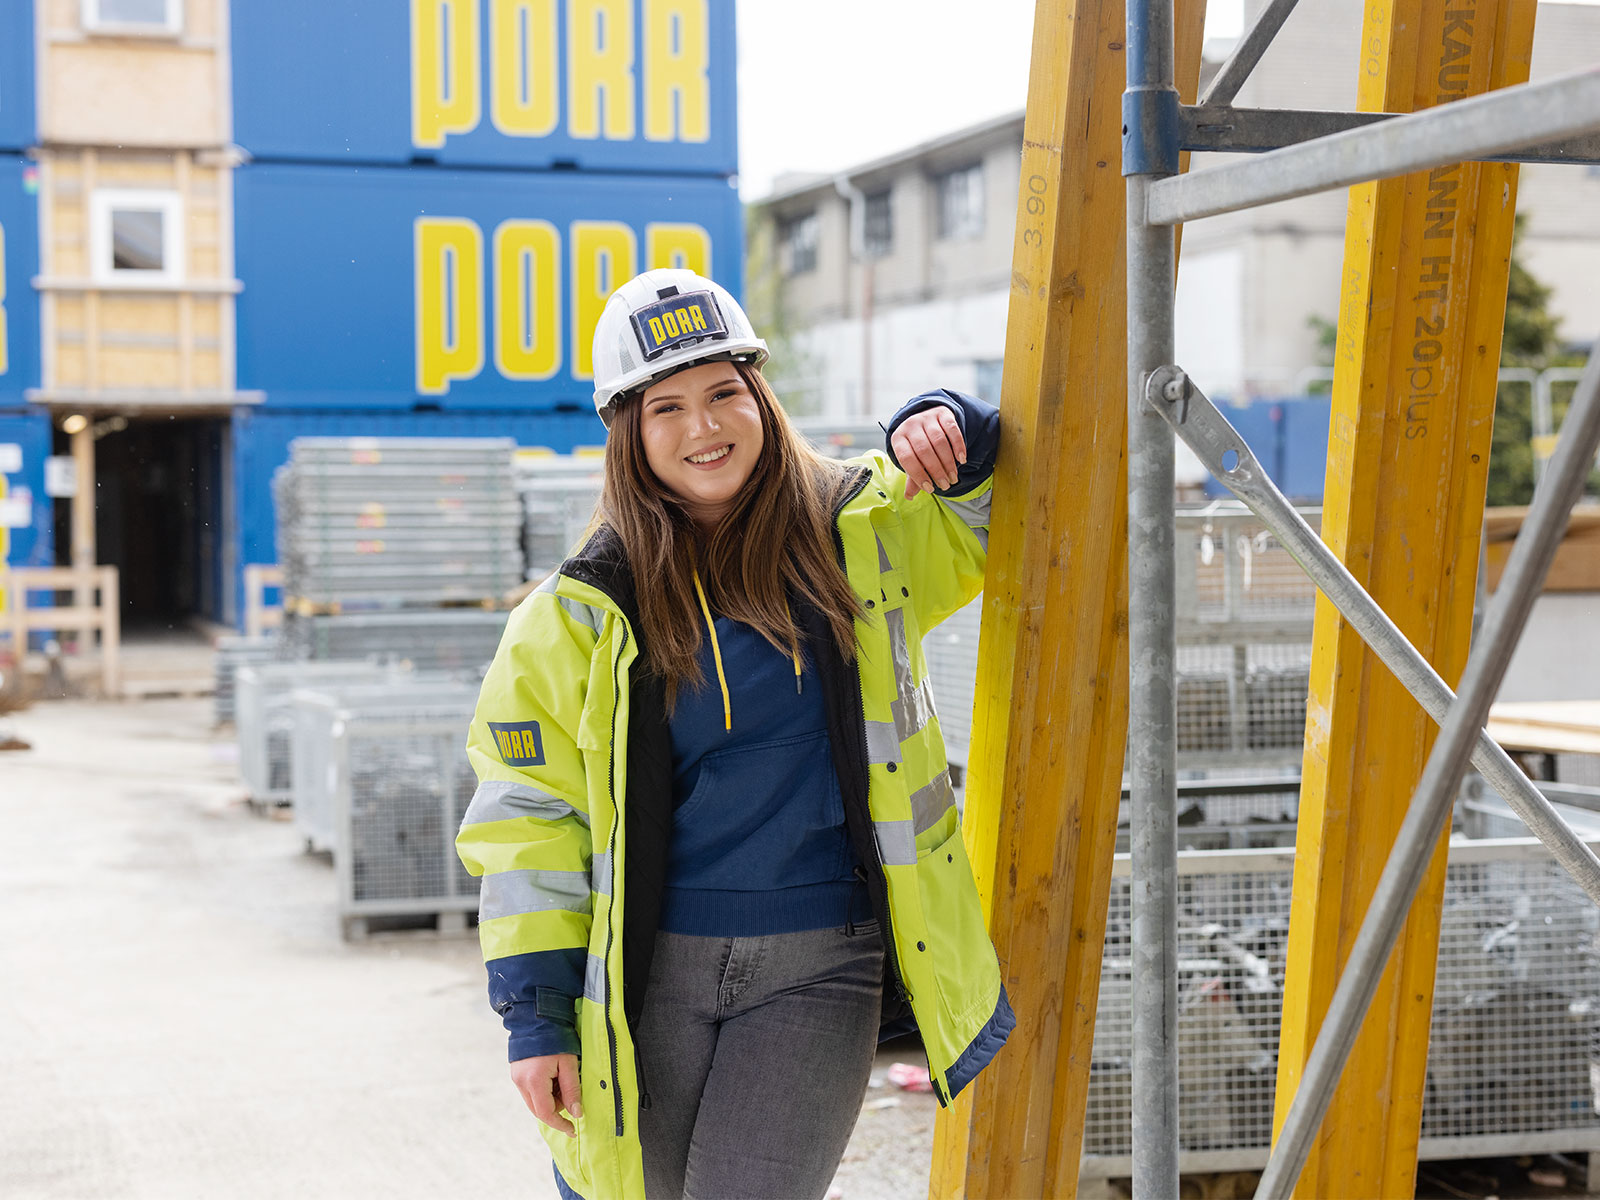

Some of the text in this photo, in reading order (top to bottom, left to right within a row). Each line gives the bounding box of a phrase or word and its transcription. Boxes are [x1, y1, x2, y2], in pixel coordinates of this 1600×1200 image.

[411, 0, 711, 149] PORR
[1366, 5, 1385, 78] 3.90
[1023, 174, 1048, 249] 3.90
[1417, 255, 1452, 304] HT
[647, 304, 708, 346] PORR
[1404, 315, 1446, 441] 20plus
[495, 729, 537, 759] PORR
